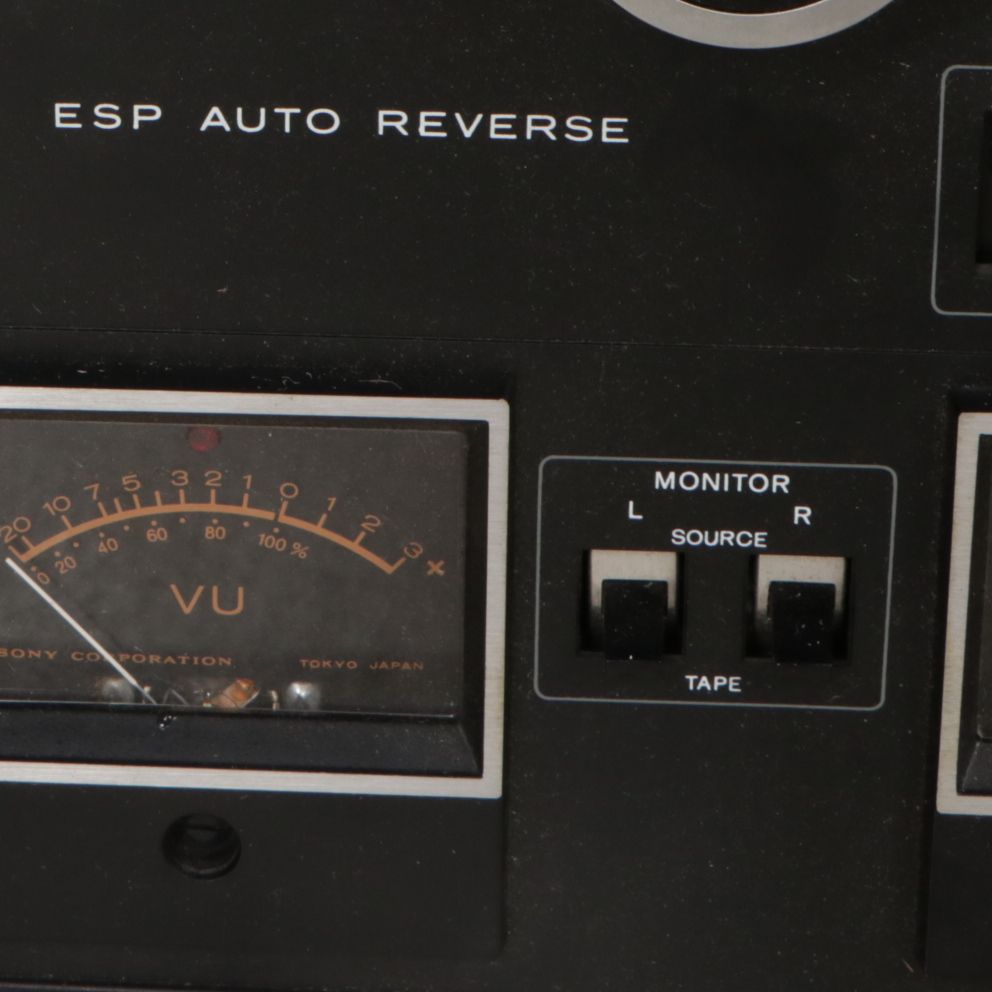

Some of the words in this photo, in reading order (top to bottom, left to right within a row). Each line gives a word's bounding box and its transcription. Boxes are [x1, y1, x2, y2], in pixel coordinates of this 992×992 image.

[55, 103, 161, 129] ESP
[200, 106, 340, 134] AUTO
[378, 110, 628, 142] REVERSE
[655, 471, 789, 493] MONITOR
[42, 495, 72, 516] 10
[83, 483, 100, 501] 7
[122, 475, 141, 491] 5
[171, 470, 189, 486] 3
[205, 470, 222, 486] 2
[243, 475, 252, 489] 1
[328, 497, 336, 511] 1
[361, 514, 381, 532] 2
[629, 501, 643, 519] L
[794, 506, 811, 524] R
[672, 529, 767, 547] SOURCE
[55, 556, 77, 574] 20
[98, 538, 118, 553] 40
[147, 528, 167, 542] 60
[205, 526, 226, 539] 80
[258, 533, 287, 551] 100
[170, 584, 244, 615] VU
[70, 651, 232, 667] COPORATION
[299, 658, 358, 670] TOKYO
[369, 660, 425, 671] JAPAN
[685, 675, 741, 692] TAPE
